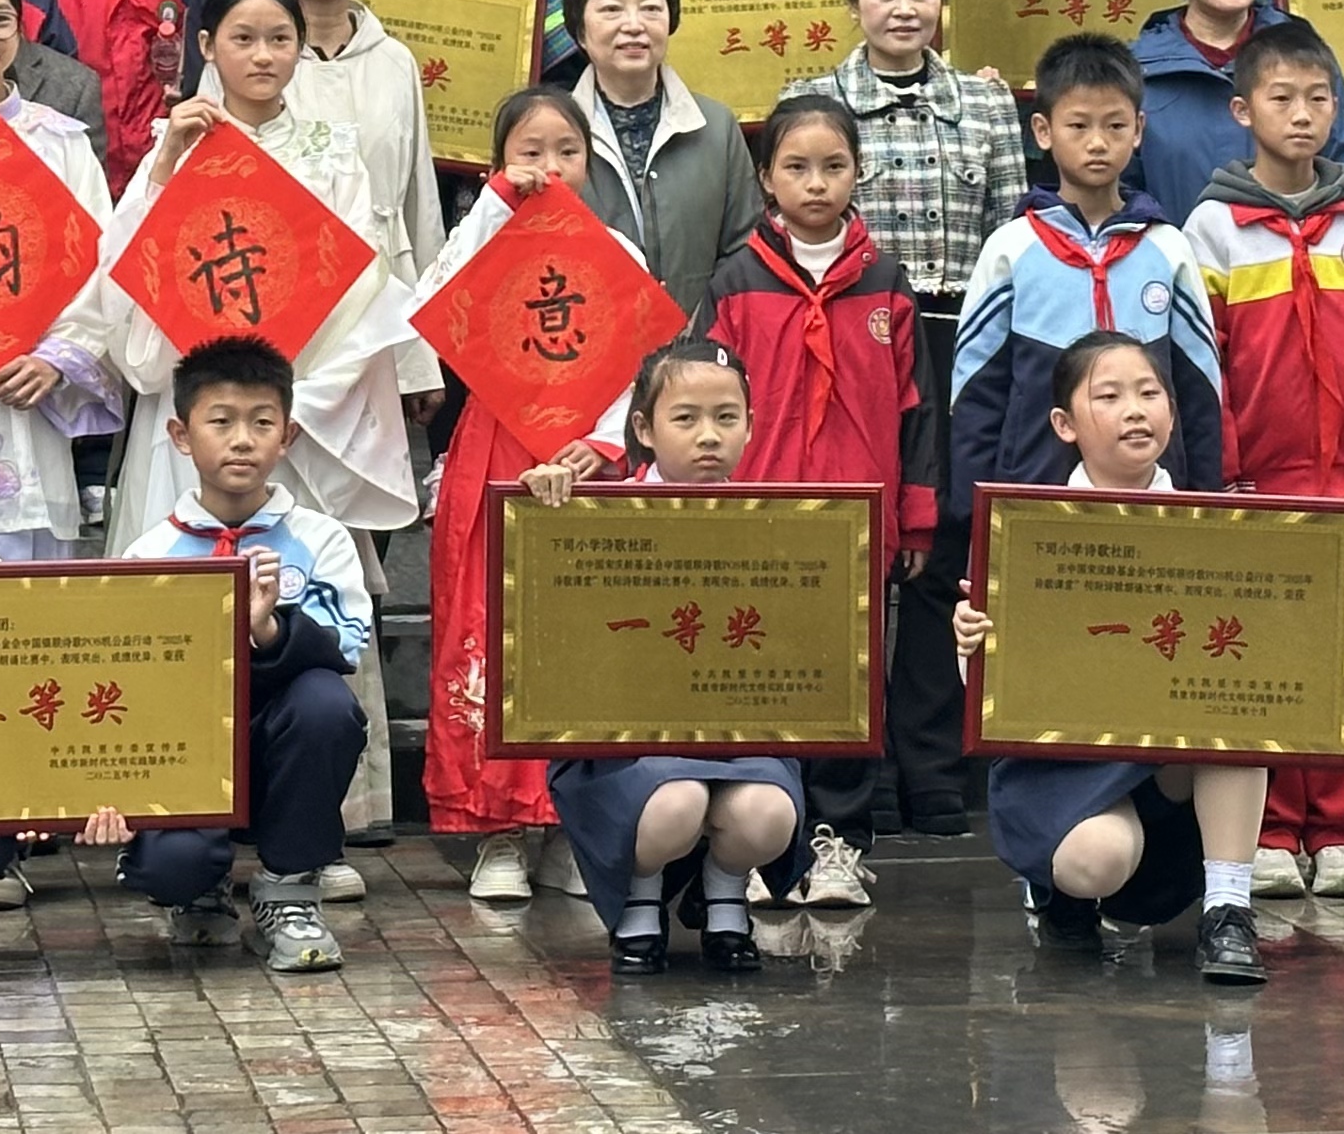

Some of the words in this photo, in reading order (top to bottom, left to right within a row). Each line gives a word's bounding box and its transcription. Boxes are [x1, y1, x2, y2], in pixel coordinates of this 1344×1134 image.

[719, 19, 837, 57] 三等奖
[188, 211, 267, 325] 诗
[524, 267, 586, 363] 意
[606, 601, 767, 654] 一等奖
[1087, 609, 1248, 661] 一等奖
